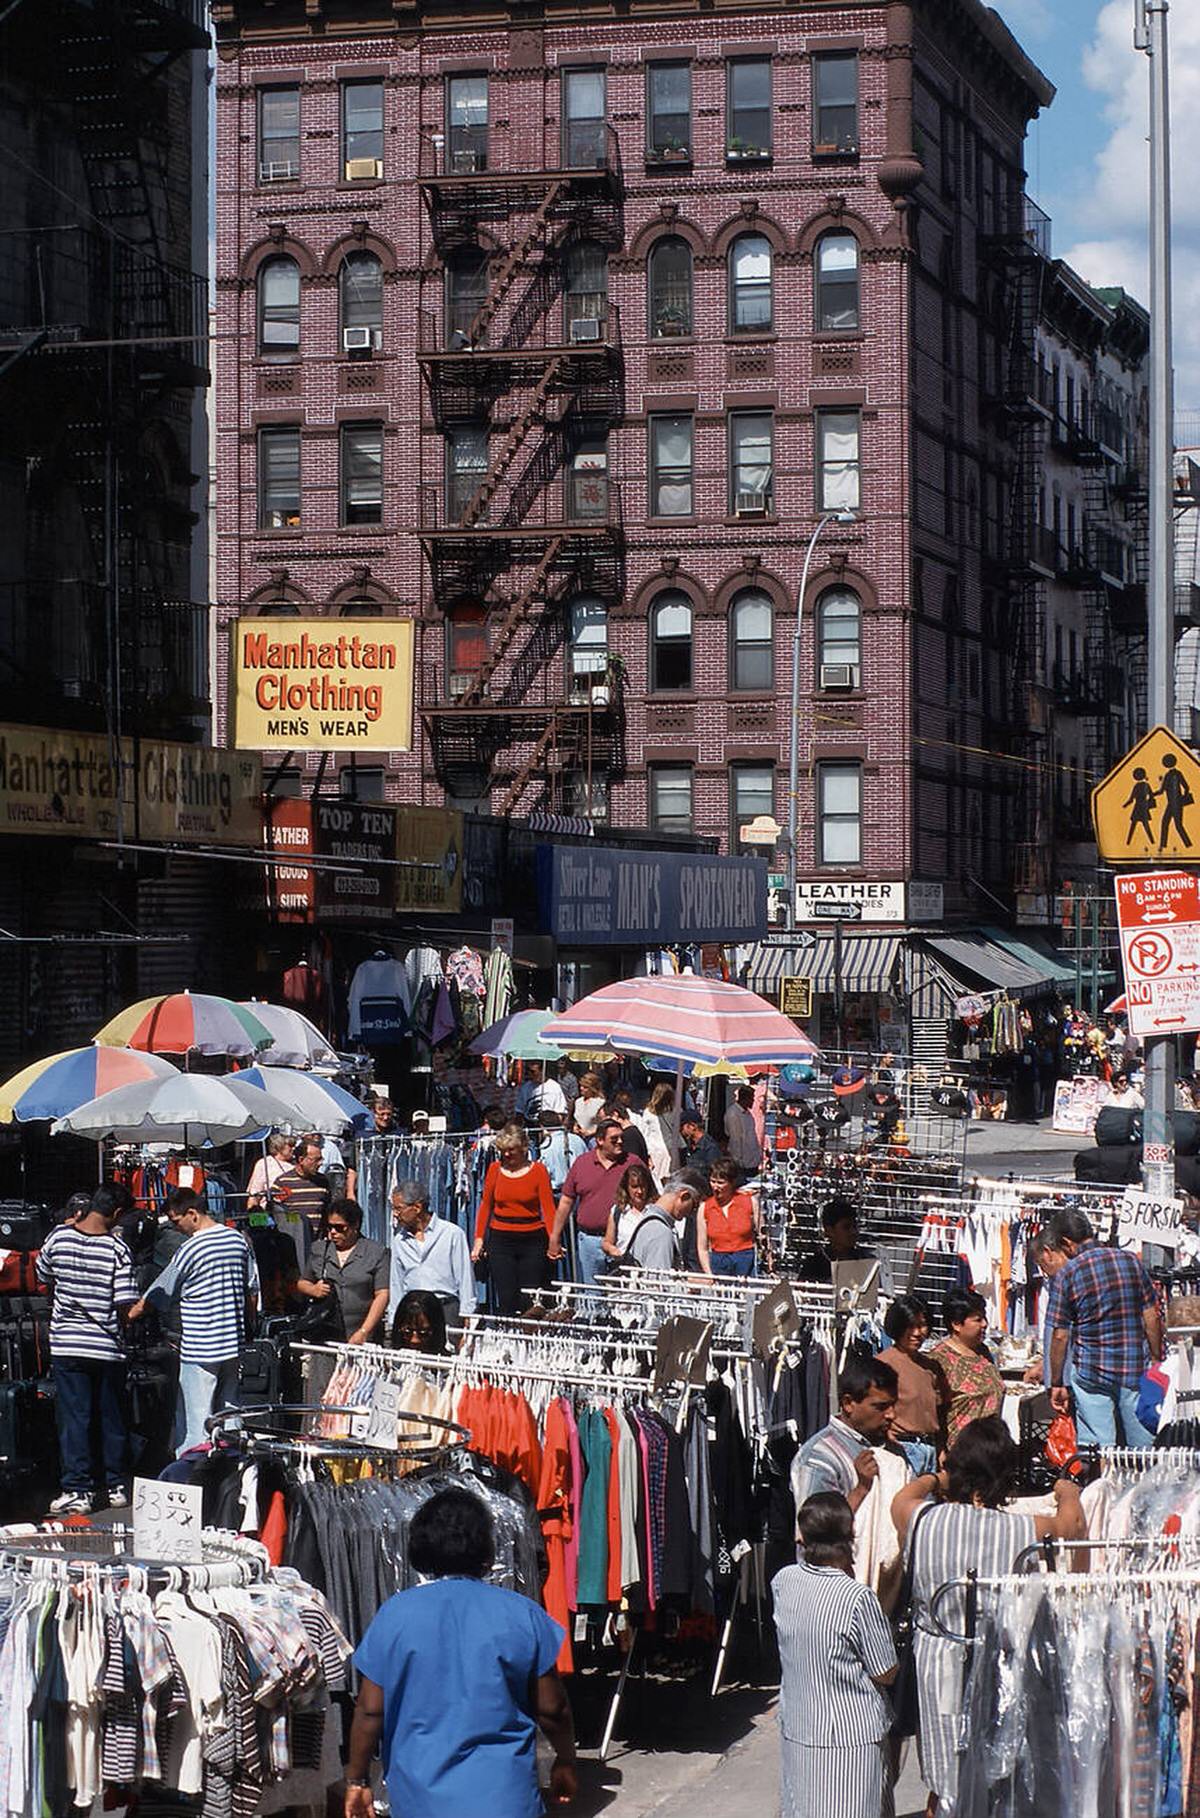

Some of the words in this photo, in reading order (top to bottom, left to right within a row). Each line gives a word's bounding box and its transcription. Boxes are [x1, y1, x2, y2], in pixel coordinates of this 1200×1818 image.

[244, 632, 396, 669] Manhattan
[256, 674, 383, 722] Clothing
[267, 717, 310, 736] MEN'S
[320, 721, 368, 736] WEAR
[0, 736, 119, 799] anhatta
[144, 749, 231, 826] Clothing
[319, 807, 353, 830] TOP
[361, 812, 393, 835] TEN
[617, 863, 661, 929] MAN'S
[680, 866, 757, 929] SPORTSWEAR
[799, 885, 892, 898] LEATHER
[1121, 881, 1136, 894] NO
[1144, 877, 1195, 892] STANDING
[818, 906, 830, 914] ONE
[767, 935, 783, 944] NE
[1130, 982, 1151, 1003] NO
[1157, 981, 1200, 993] PARKING
